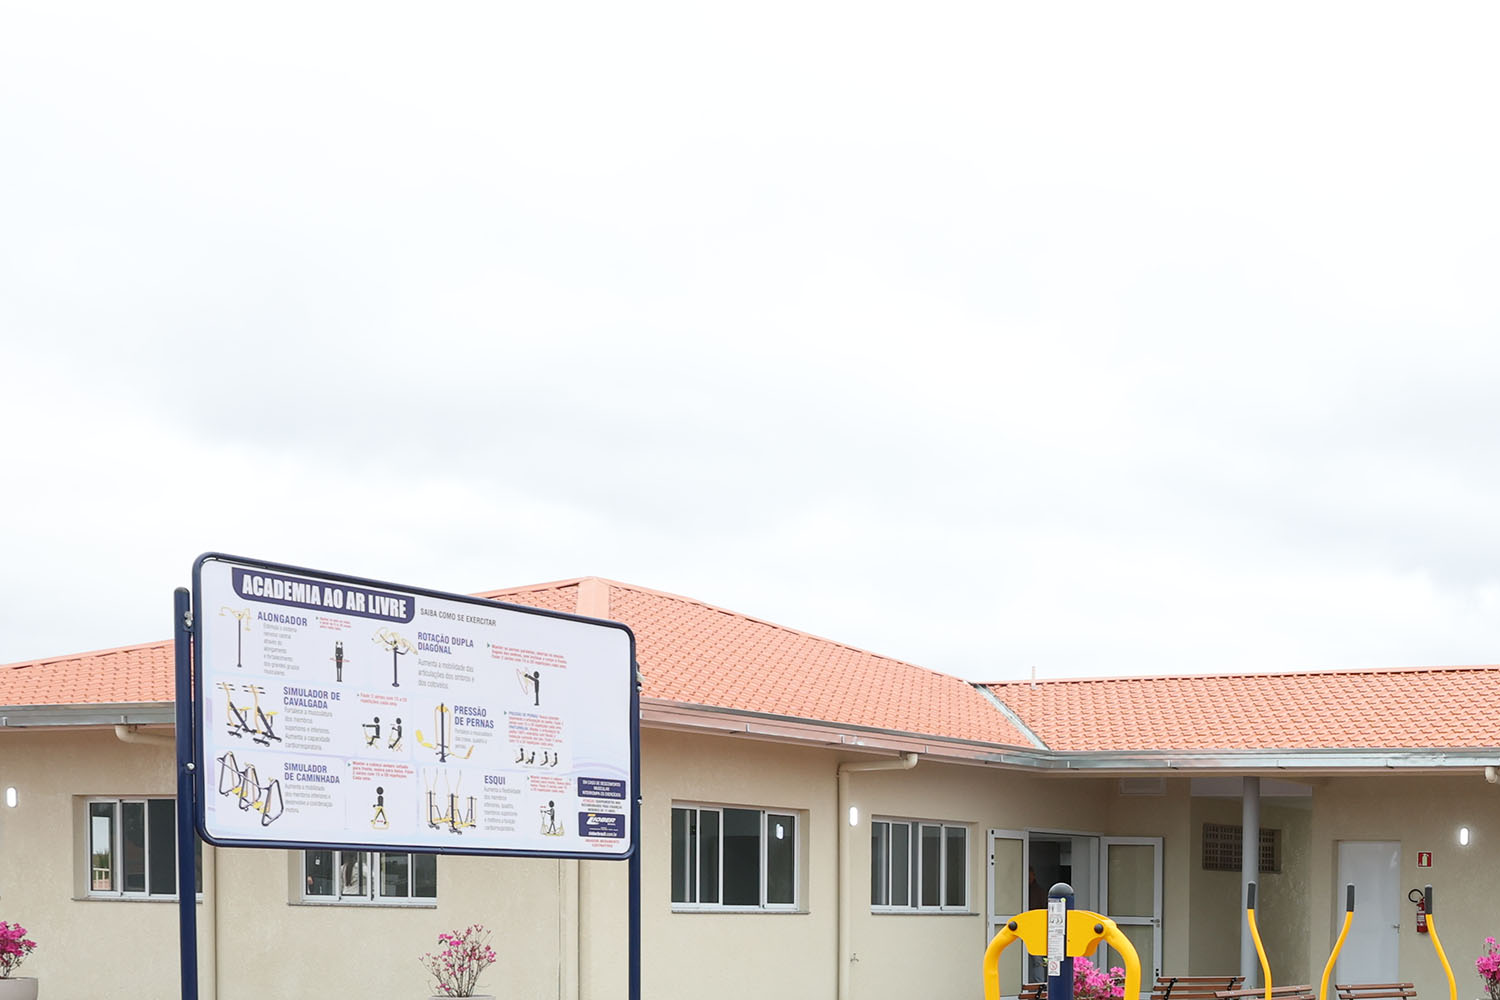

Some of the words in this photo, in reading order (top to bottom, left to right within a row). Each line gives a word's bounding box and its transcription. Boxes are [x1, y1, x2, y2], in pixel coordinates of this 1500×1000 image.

[242, 574, 321, 605] ACADEMIA
[324, 588, 343, 608] AO
[346, 591, 366, 612] AR
[368, 594, 407, 618] LIVRE
[258, 611, 307, 627] ALONGADOR
[420, 608, 437, 617] SAIBA
[438, 610, 456, 620] COMO
[457, 614, 464, 622] SE
[466, 615, 496, 627] EXERCITAR
[418, 632, 449, 645] ROTAÇÃO
[452, 636, 474, 648] DUPLA
[418, 642, 452, 655] DIAGONAL
[283, 687, 328, 700] SIMULADOR
[331, 691, 340, 700] DE
[284, 697, 328, 709] CAVALGADA
[454, 705, 486, 717] PRESSÃO
[455, 716, 464, 726] DE
[466, 717, 494, 728] PERNAS
[284, 762, 327, 773] SIMULADOR
[284, 772, 294, 781] DE
[296, 773, 340, 784] CAMINHADA
[485, 775, 505, 786] ESQUI
